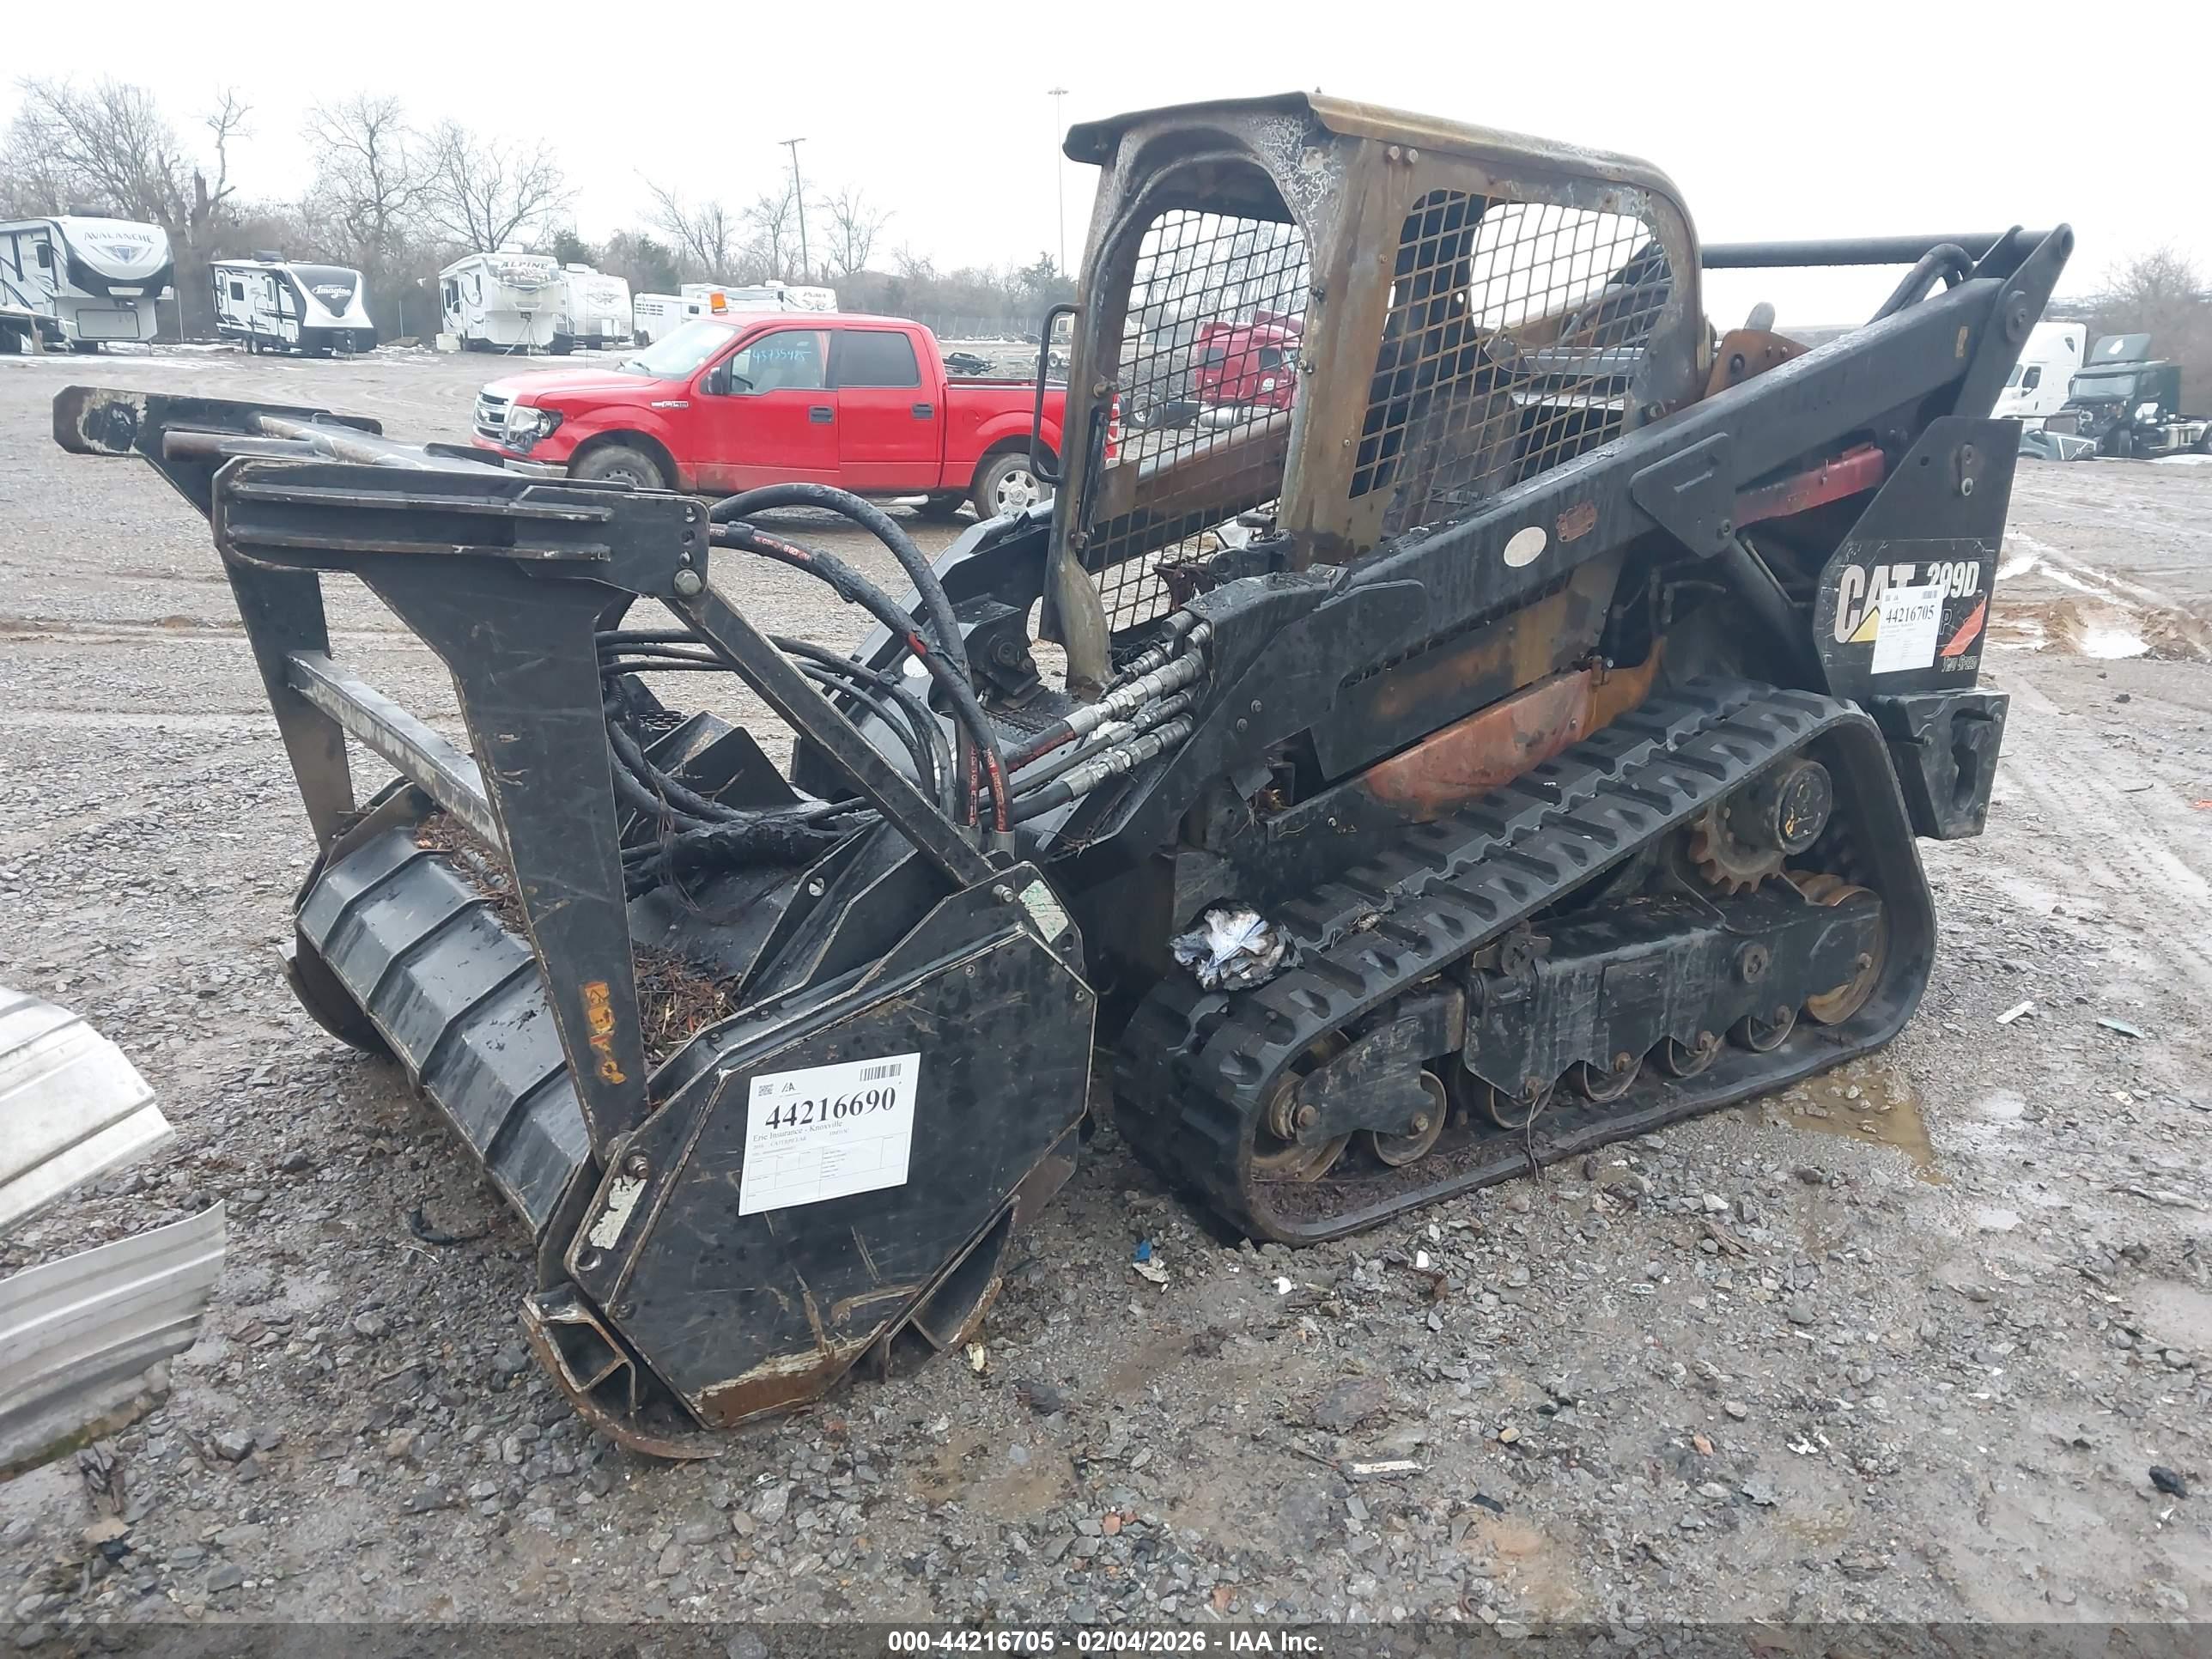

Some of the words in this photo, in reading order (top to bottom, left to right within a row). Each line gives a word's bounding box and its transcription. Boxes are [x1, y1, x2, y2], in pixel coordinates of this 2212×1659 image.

[84, 231, 155, 244] AVALANCHE
[315, 284, 352, 299] Imagine
[1926, 561, 1980, 599] 299D
[1885, 605, 1935, 624] 44216705
[765, 1086, 896, 1130] 44216690
[769, 1127, 803, 1139] Insurance
[809, 1121, 843, 1132] Knoxville
